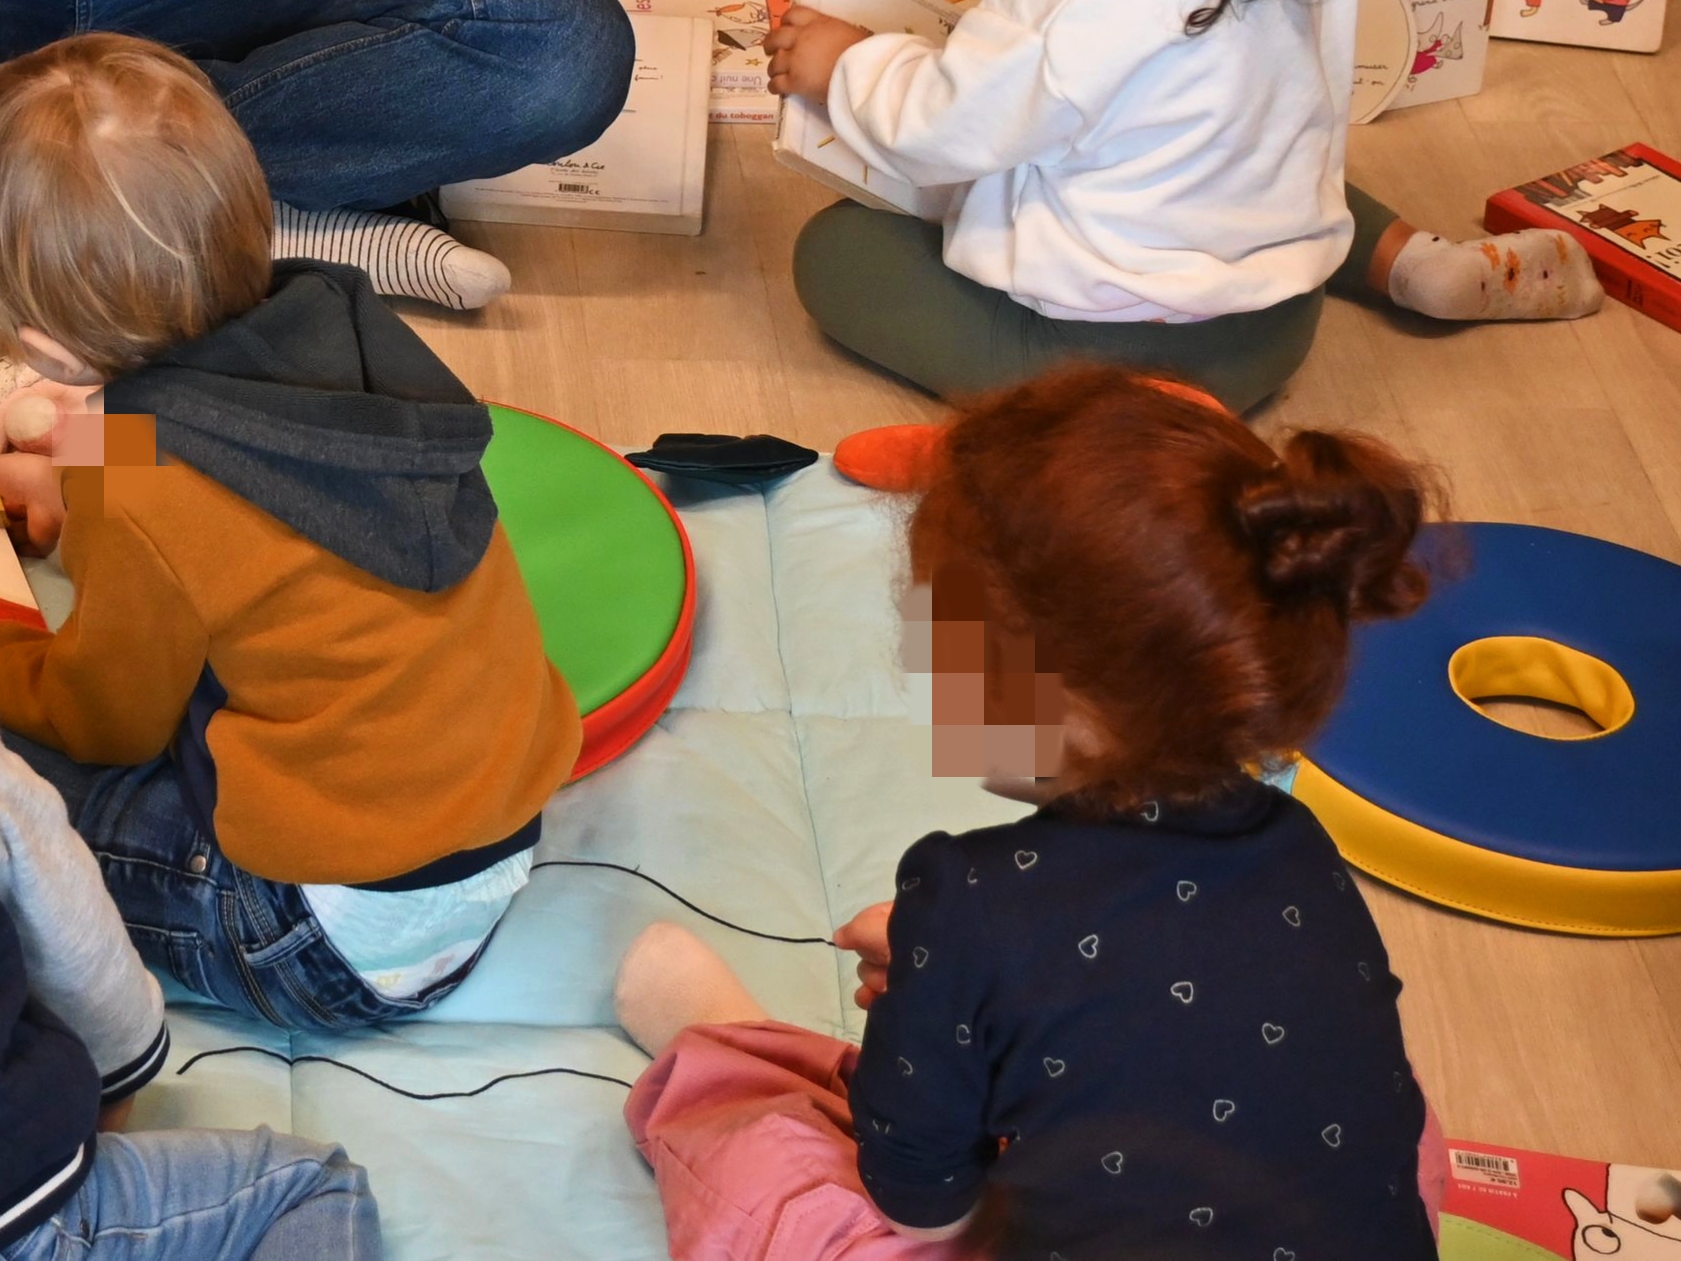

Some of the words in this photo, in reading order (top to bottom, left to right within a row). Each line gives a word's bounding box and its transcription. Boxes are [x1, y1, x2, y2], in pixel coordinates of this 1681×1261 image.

[721, 75, 739, 86] nuit
[741, 76, 762, 86] Une
[716, 111, 728, 120] du
[730, 111, 774, 121] toboggan
